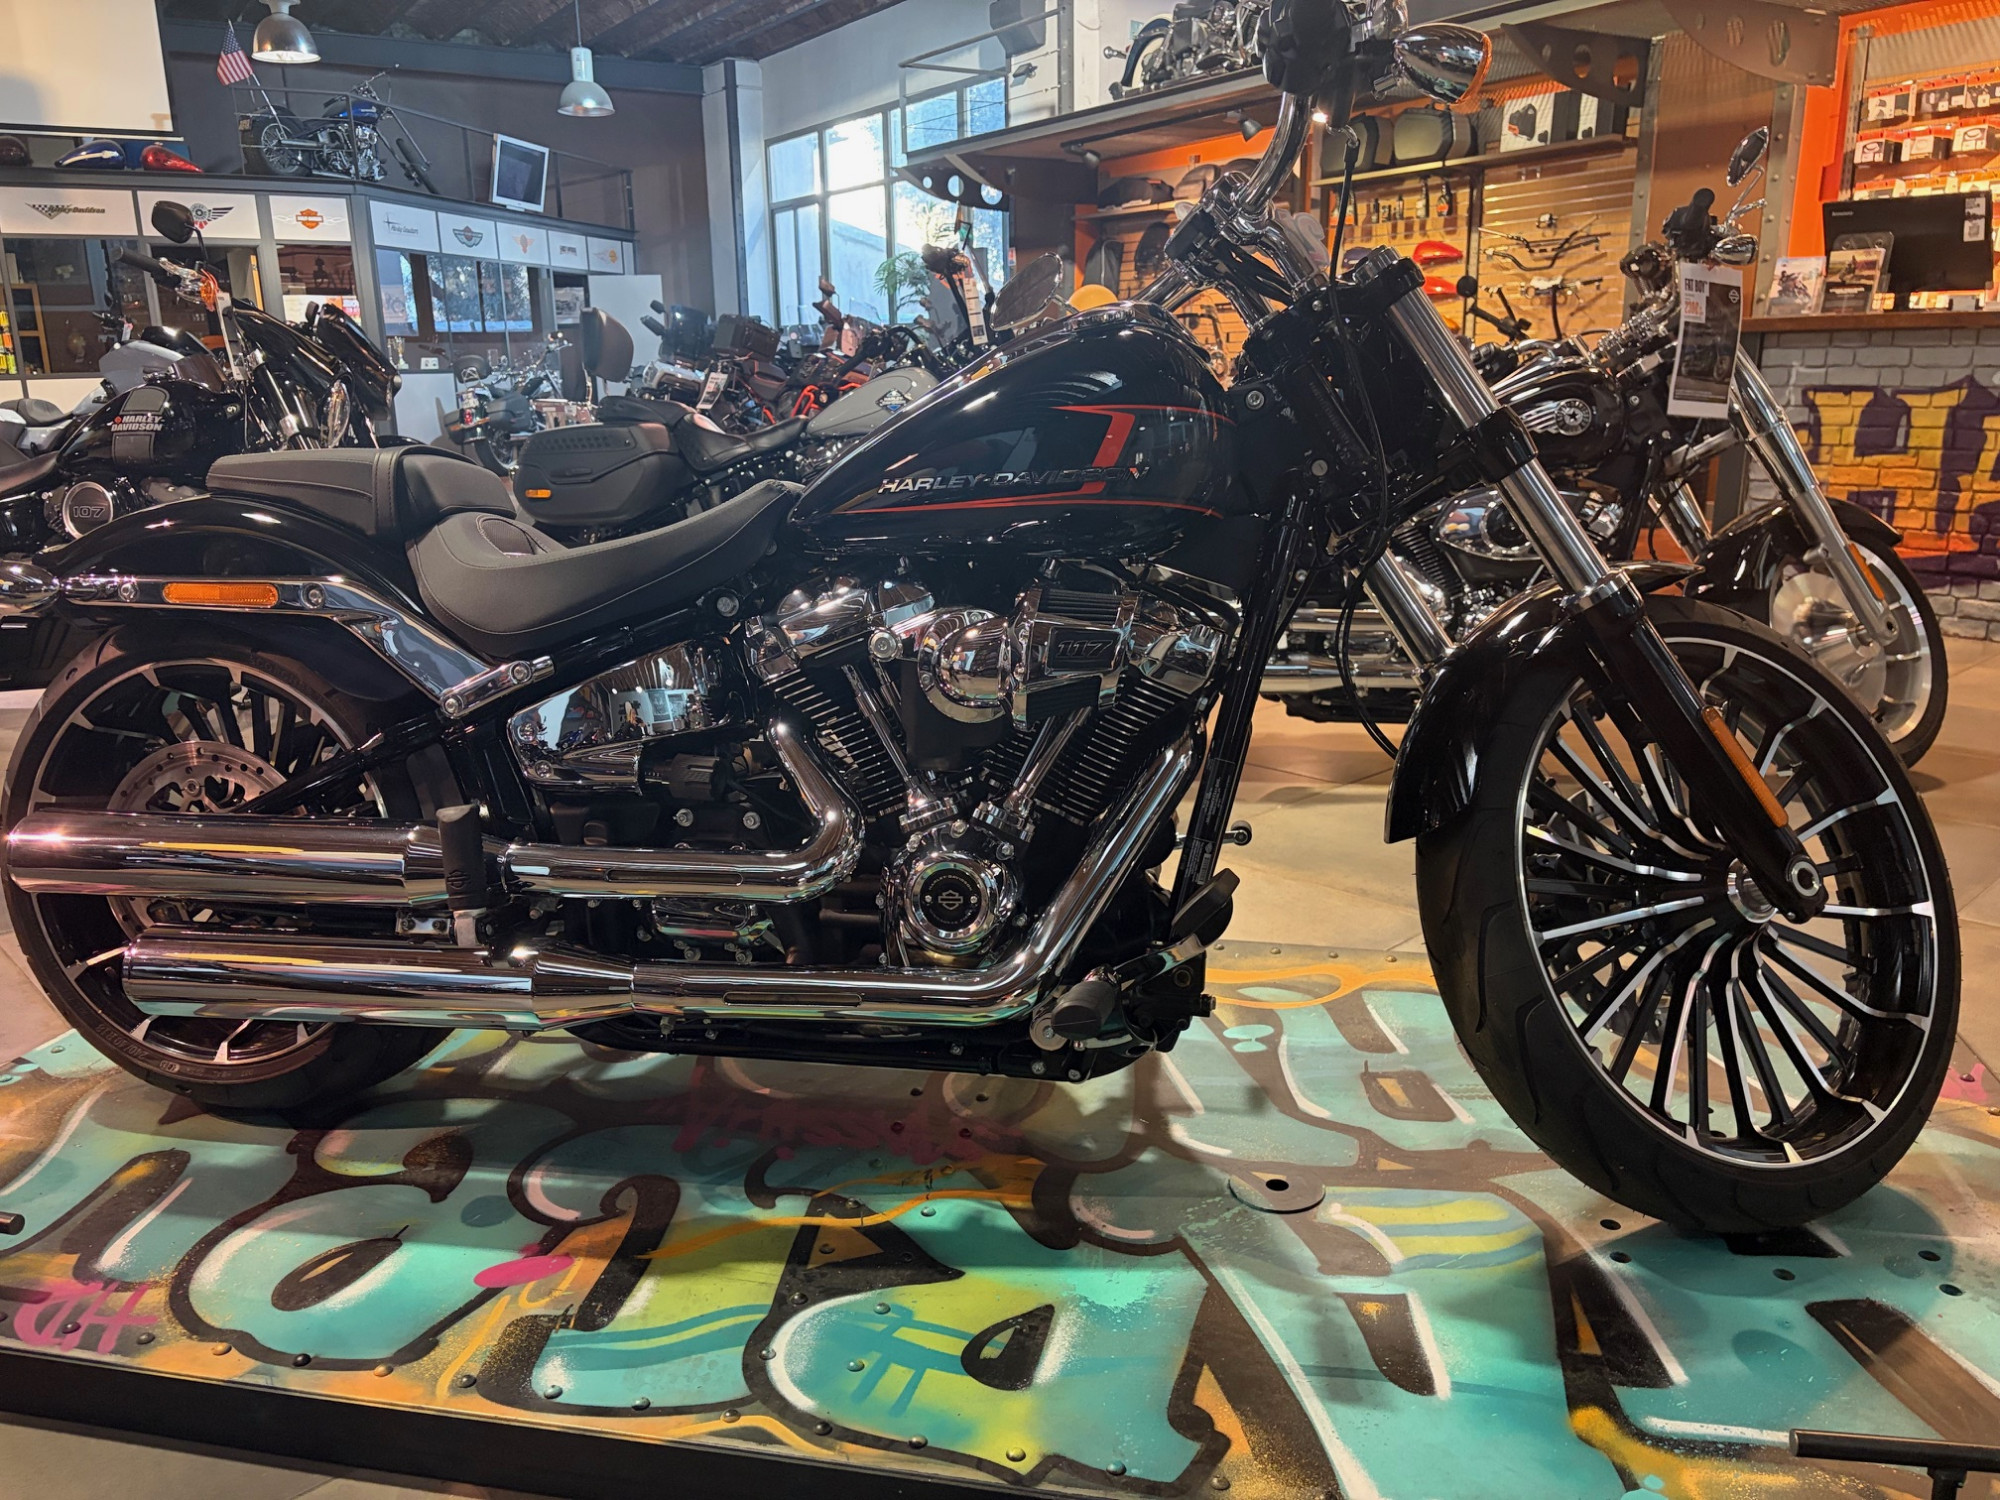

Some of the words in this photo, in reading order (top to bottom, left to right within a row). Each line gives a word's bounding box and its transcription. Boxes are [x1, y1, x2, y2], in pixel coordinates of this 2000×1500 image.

[1684, 278, 1694, 292] FAT
[122, 415, 165, 423] HARLEY-
[111, 423, 163, 432] DAVIDSON
[877, 465, 1149, 494] HARLEY-DAVIDSON
[73, 505, 105, 518] 107
[1056, 639, 1113, 658] 117
